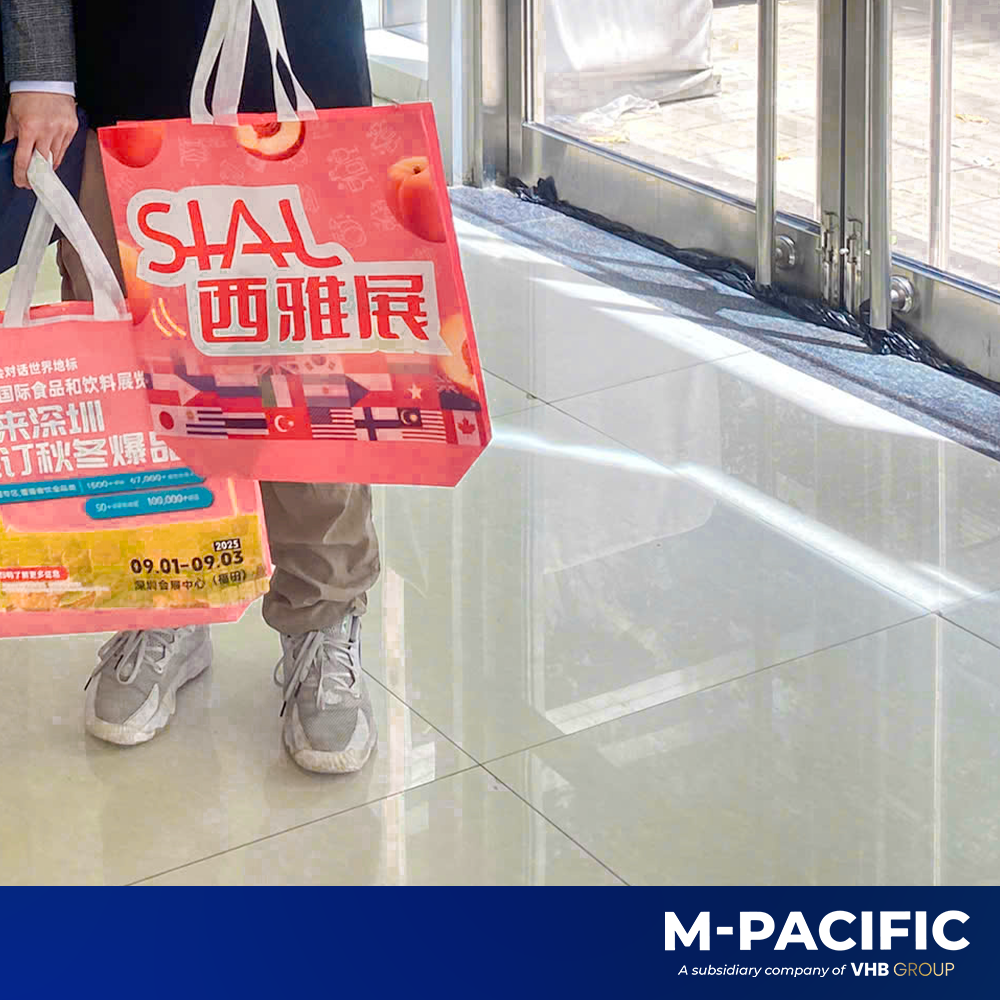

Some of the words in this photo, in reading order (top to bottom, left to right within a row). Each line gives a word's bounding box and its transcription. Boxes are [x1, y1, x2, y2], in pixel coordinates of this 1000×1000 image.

[137, 198, 343, 274] SIAL
[197, 274, 430, 343] 西雅展
[130, 550, 244, 574] 09.01-09.03
[214, 540, 240, 551] 2025
